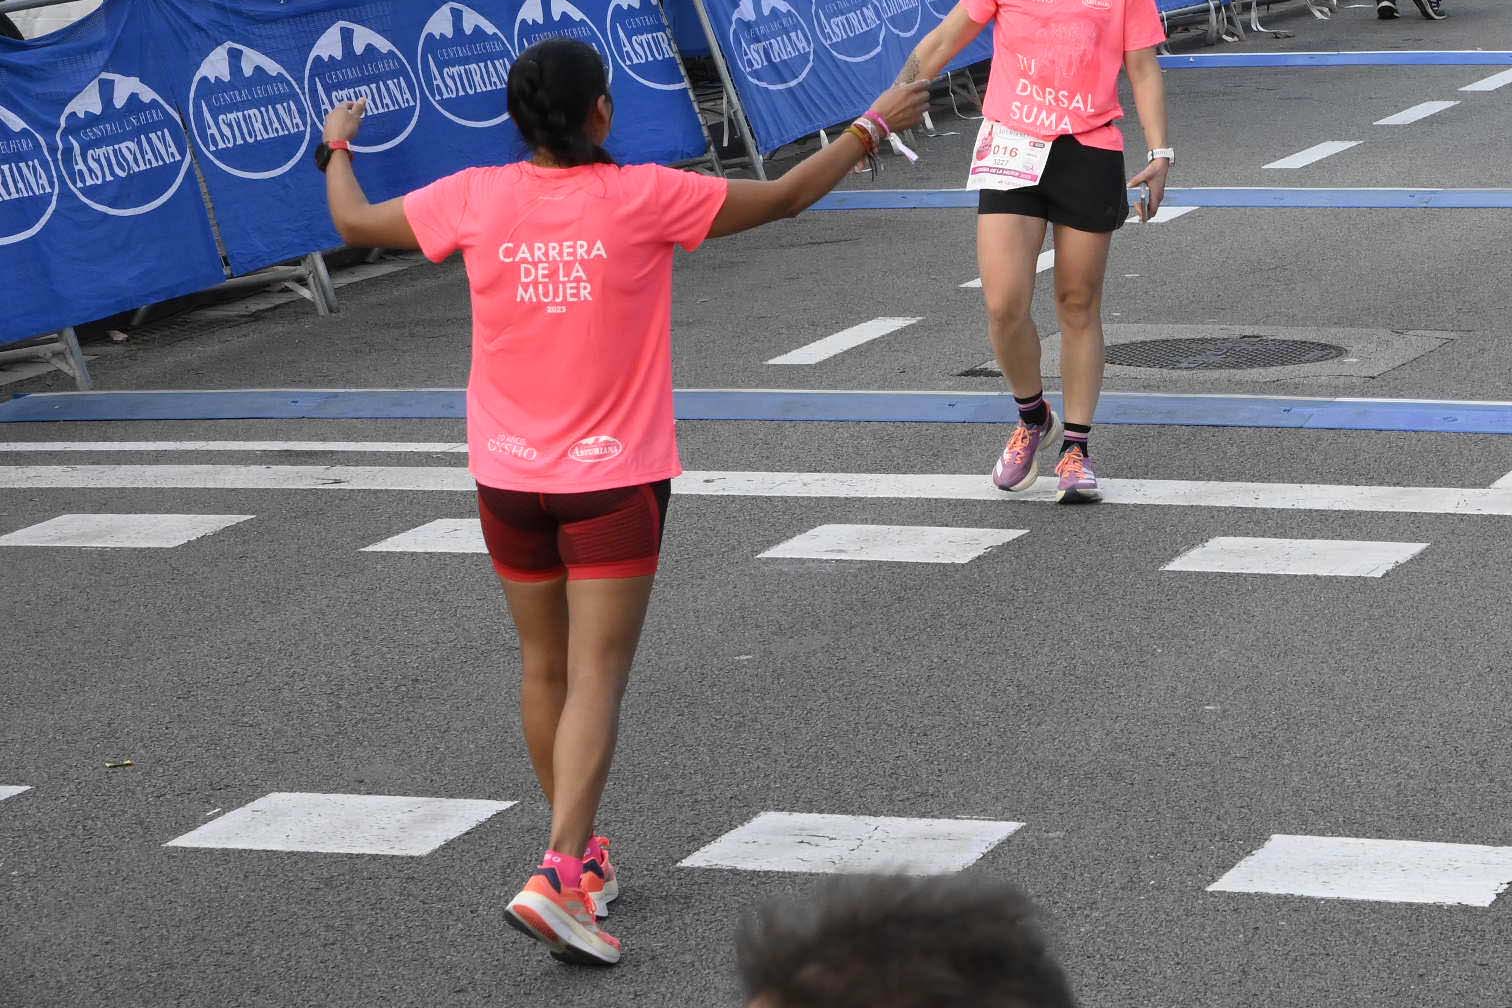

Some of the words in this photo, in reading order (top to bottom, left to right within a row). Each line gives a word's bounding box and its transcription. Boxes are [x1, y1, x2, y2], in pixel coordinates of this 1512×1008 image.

[471, 41, 504, 57] LECHERA
[326, 68, 361, 83] CENTRAL
[363, 59, 400, 77] LECHERA
[427, 53, 510, 101] ASTURIAN
[212, 87, 250, 107] CENTRAL
[252, 81, 290, 100] LECHERA
[1017, 79, 1095, 113] DORSAL
[201, 97, 305, 152] ASTURIANA
[1010, 101, 1072, 134] SUMA
[498, 239, 608, 263] CARRERA
[520, 263, 550, 283] DE
[559, 262, 588, 282] LA
[516, 282, 592, 303] MUJER
